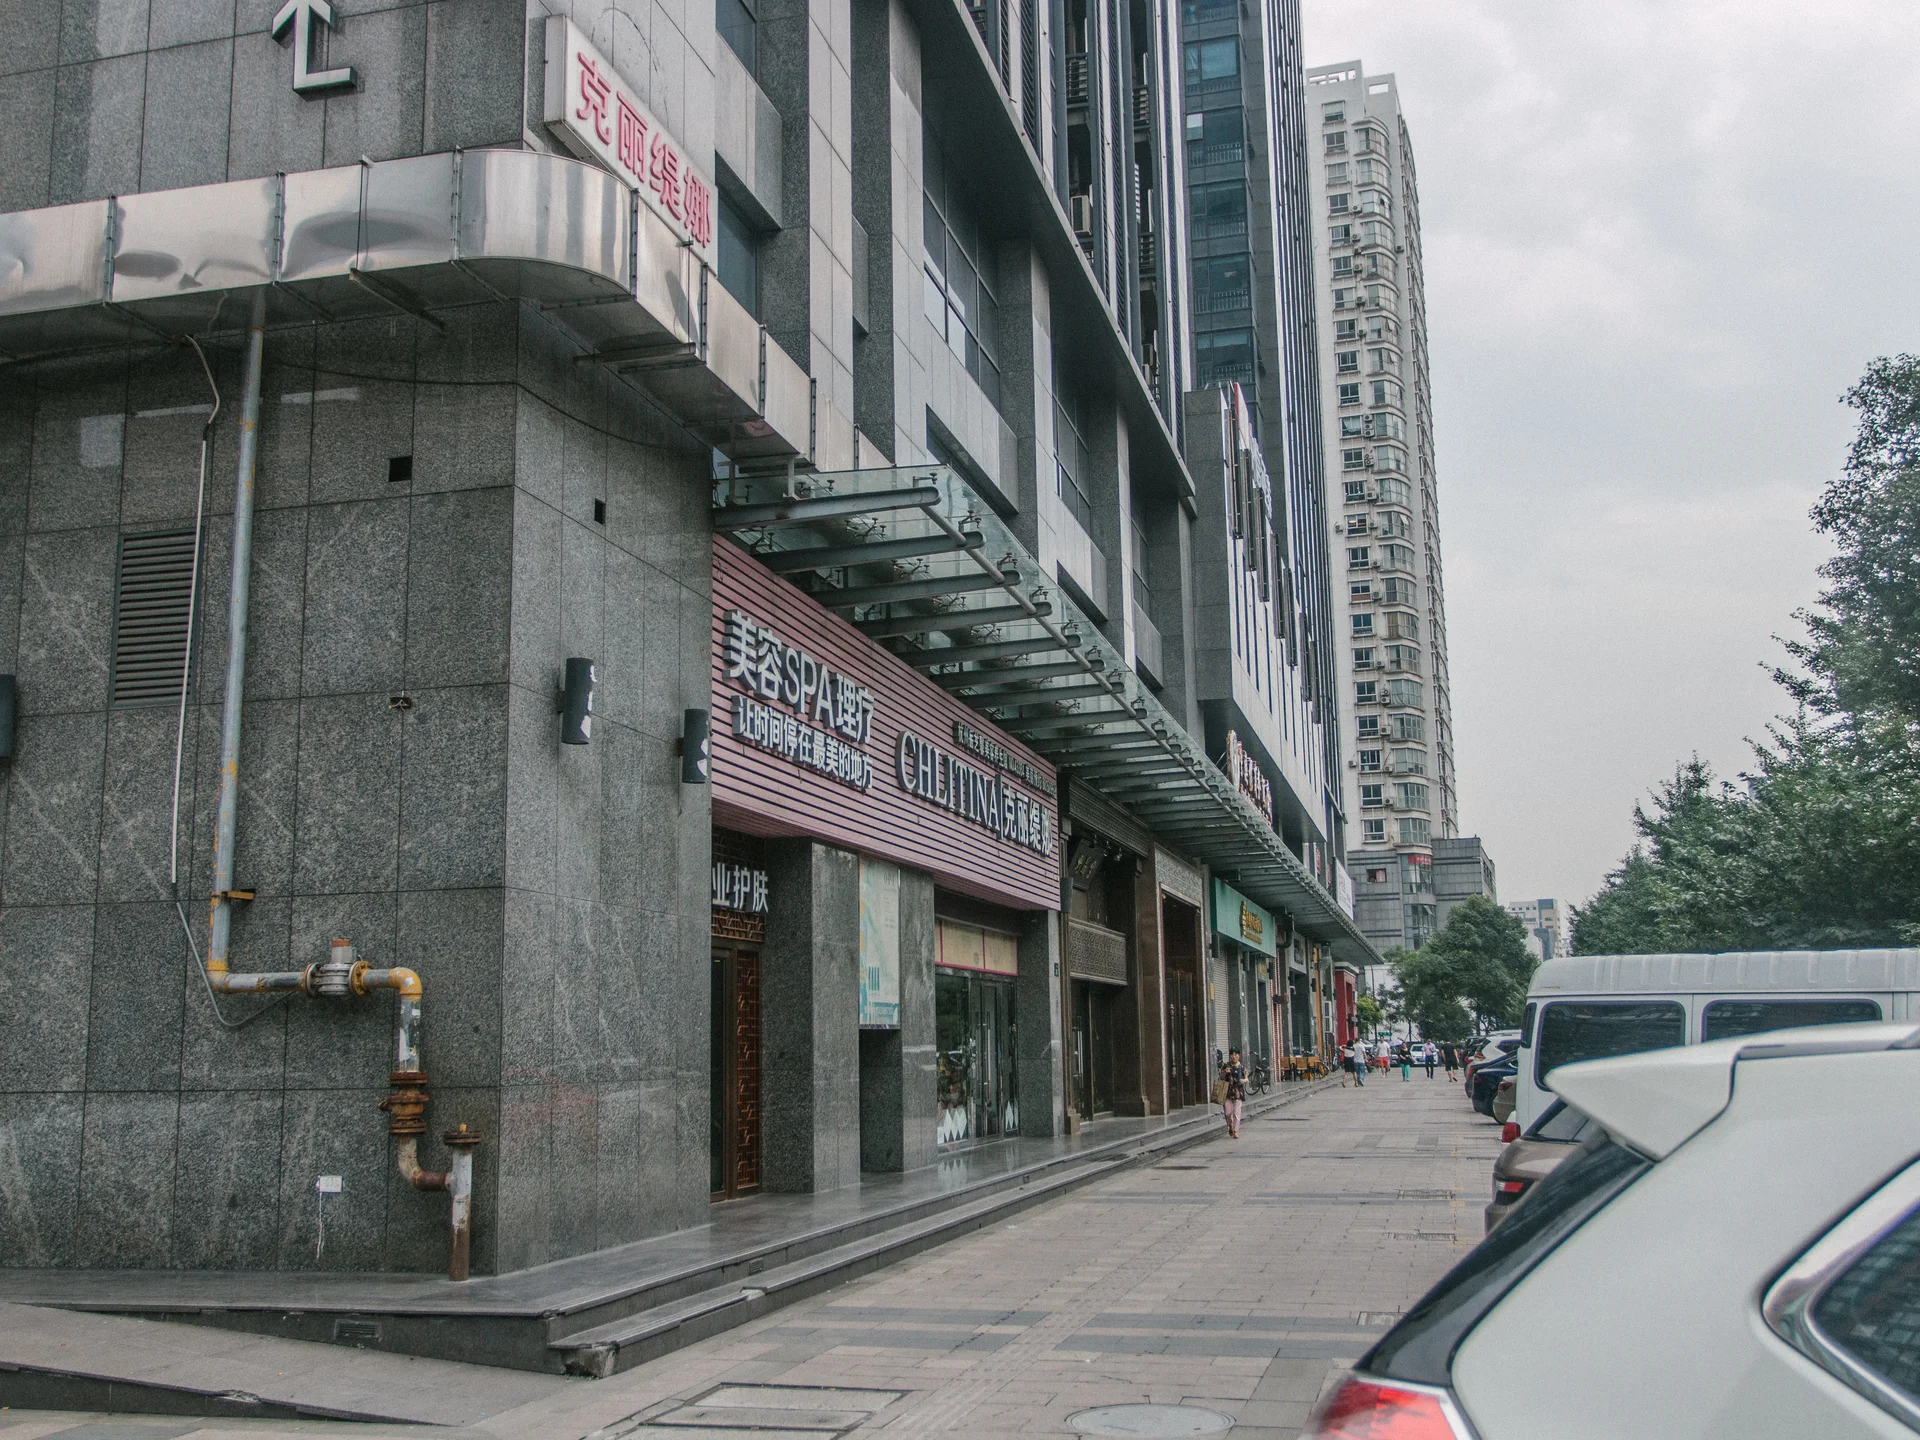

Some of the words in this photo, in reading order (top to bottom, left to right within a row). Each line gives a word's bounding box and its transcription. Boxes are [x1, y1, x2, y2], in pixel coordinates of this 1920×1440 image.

[576, 51, 712, 249] 克丽缇娜
[724, 609, 875, 744] 美容SPA理疗
[732, 695, 873, 789] 让时间停在最美的地方
[897, 731, 1000, 831] CHLITINA
[1002, 784, 1053, 856] 克丽缇娜
